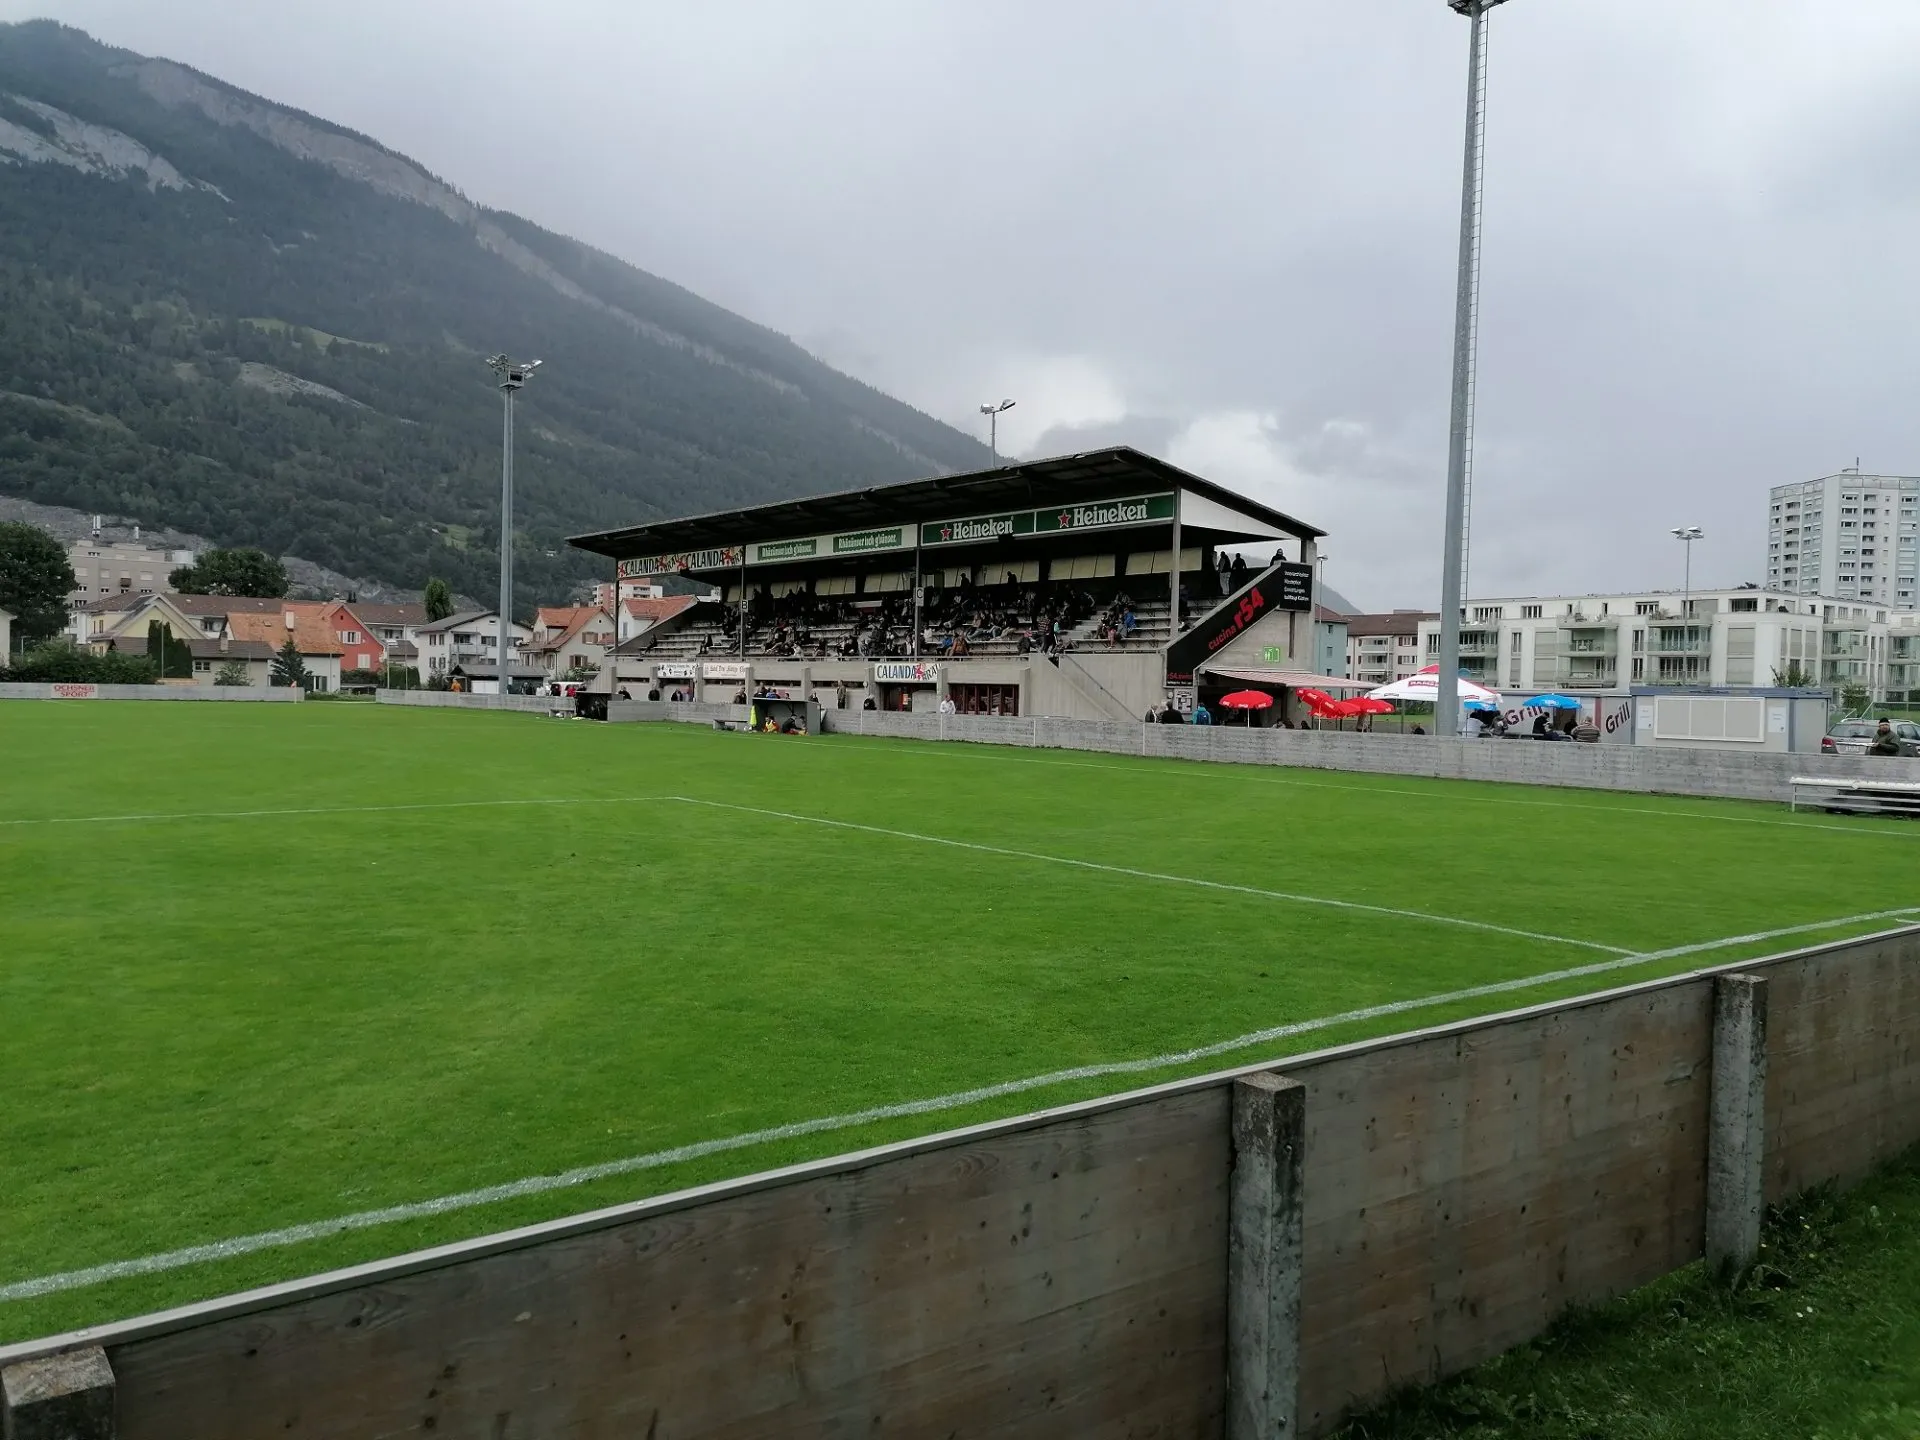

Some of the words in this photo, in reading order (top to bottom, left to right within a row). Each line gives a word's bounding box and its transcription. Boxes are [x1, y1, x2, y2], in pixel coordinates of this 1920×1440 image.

[1072, 502, 1148, 527] Heineken
[952, 520, 1014, 540] Heineken
[625, 557, 660, 576] CALANDA
[686, 549, 725, 569] CALANDA
[916, 588, 923, 599] C
[1208, 625, 1237, 651] cucina
[1233, 586, 1265, 629] r54
[876, 664, 917, 679] CALANDA
[1505, 705, 1543, 727] Grill
[1605, 702, 1631, 734] Grill
